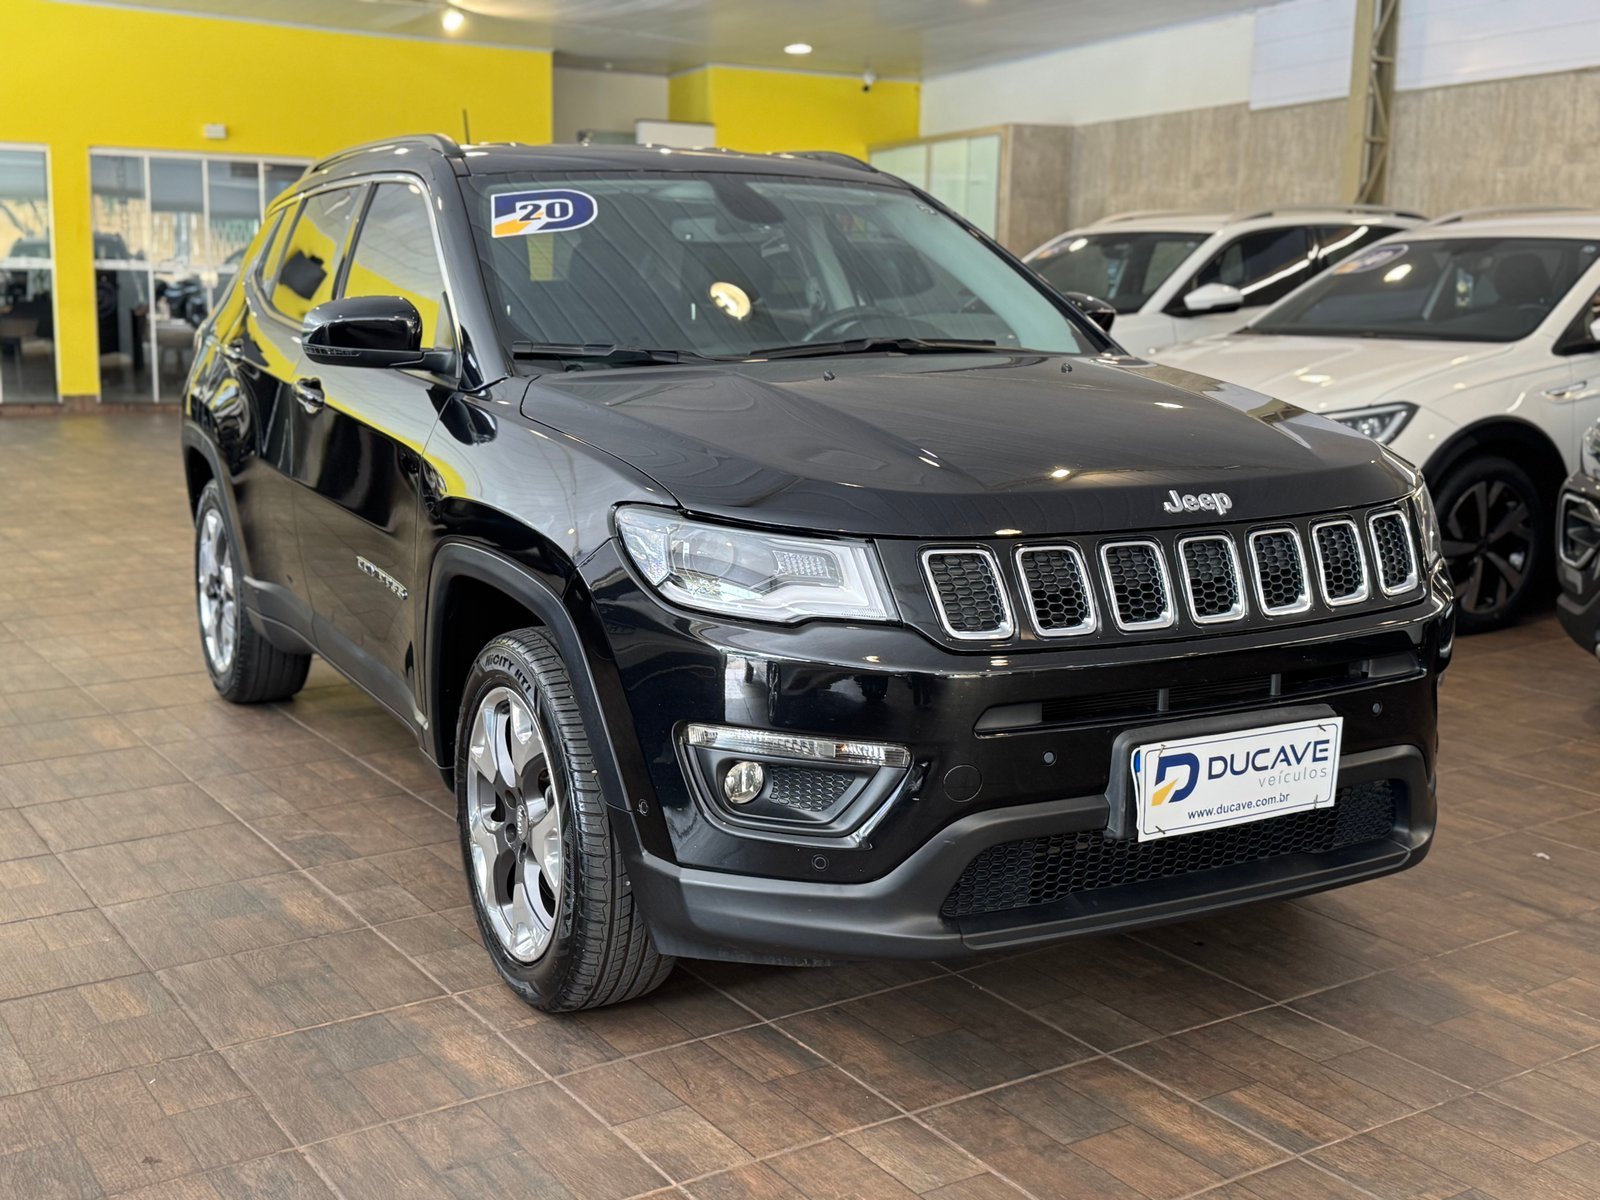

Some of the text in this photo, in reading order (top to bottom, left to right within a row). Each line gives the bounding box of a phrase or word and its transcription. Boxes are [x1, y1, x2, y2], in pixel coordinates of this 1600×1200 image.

[518, 201, 570, 222] 20
[1163, 489, 1233, 516] Jeep
[1207, 738, 1331, 781] DUCAVE
[1258, 766, 1328, 788] veículos
[1187, 791, 1290, 820] www.ducave.com.br
